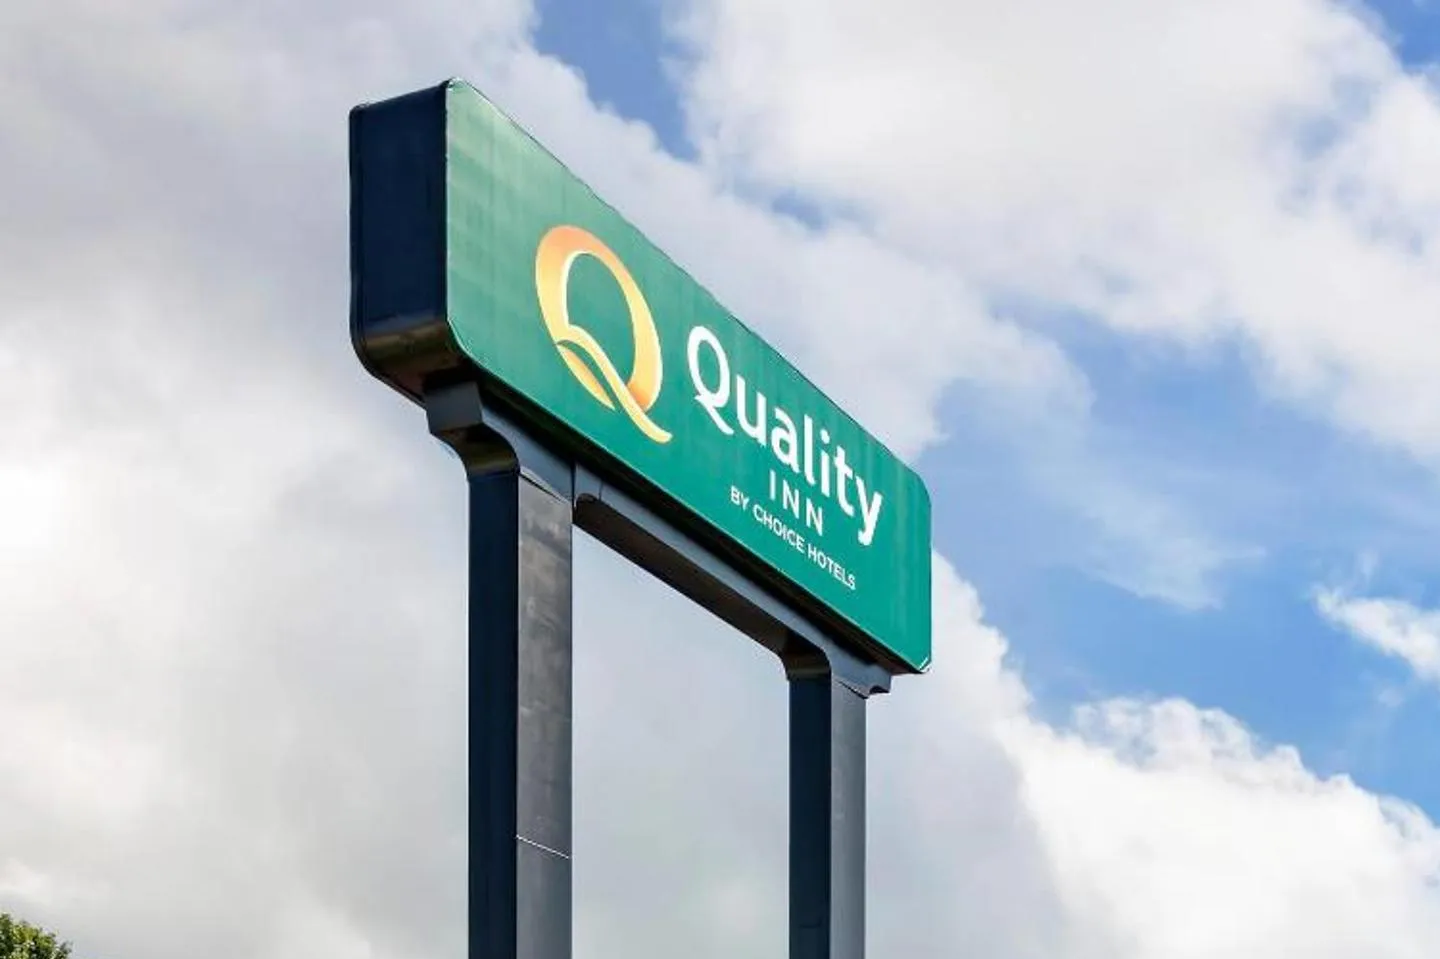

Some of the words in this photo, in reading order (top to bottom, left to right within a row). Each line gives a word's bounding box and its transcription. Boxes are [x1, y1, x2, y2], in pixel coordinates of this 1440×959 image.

[535, 225, 672, 444] Q
[687, 325, 883, 546] Quality
[769, 469, 823, 537] INN
[730, 485, 749, 511] BY
[753, 503, 805, 554] CHOICE
[807, 543, 856, 591] HOTELS
